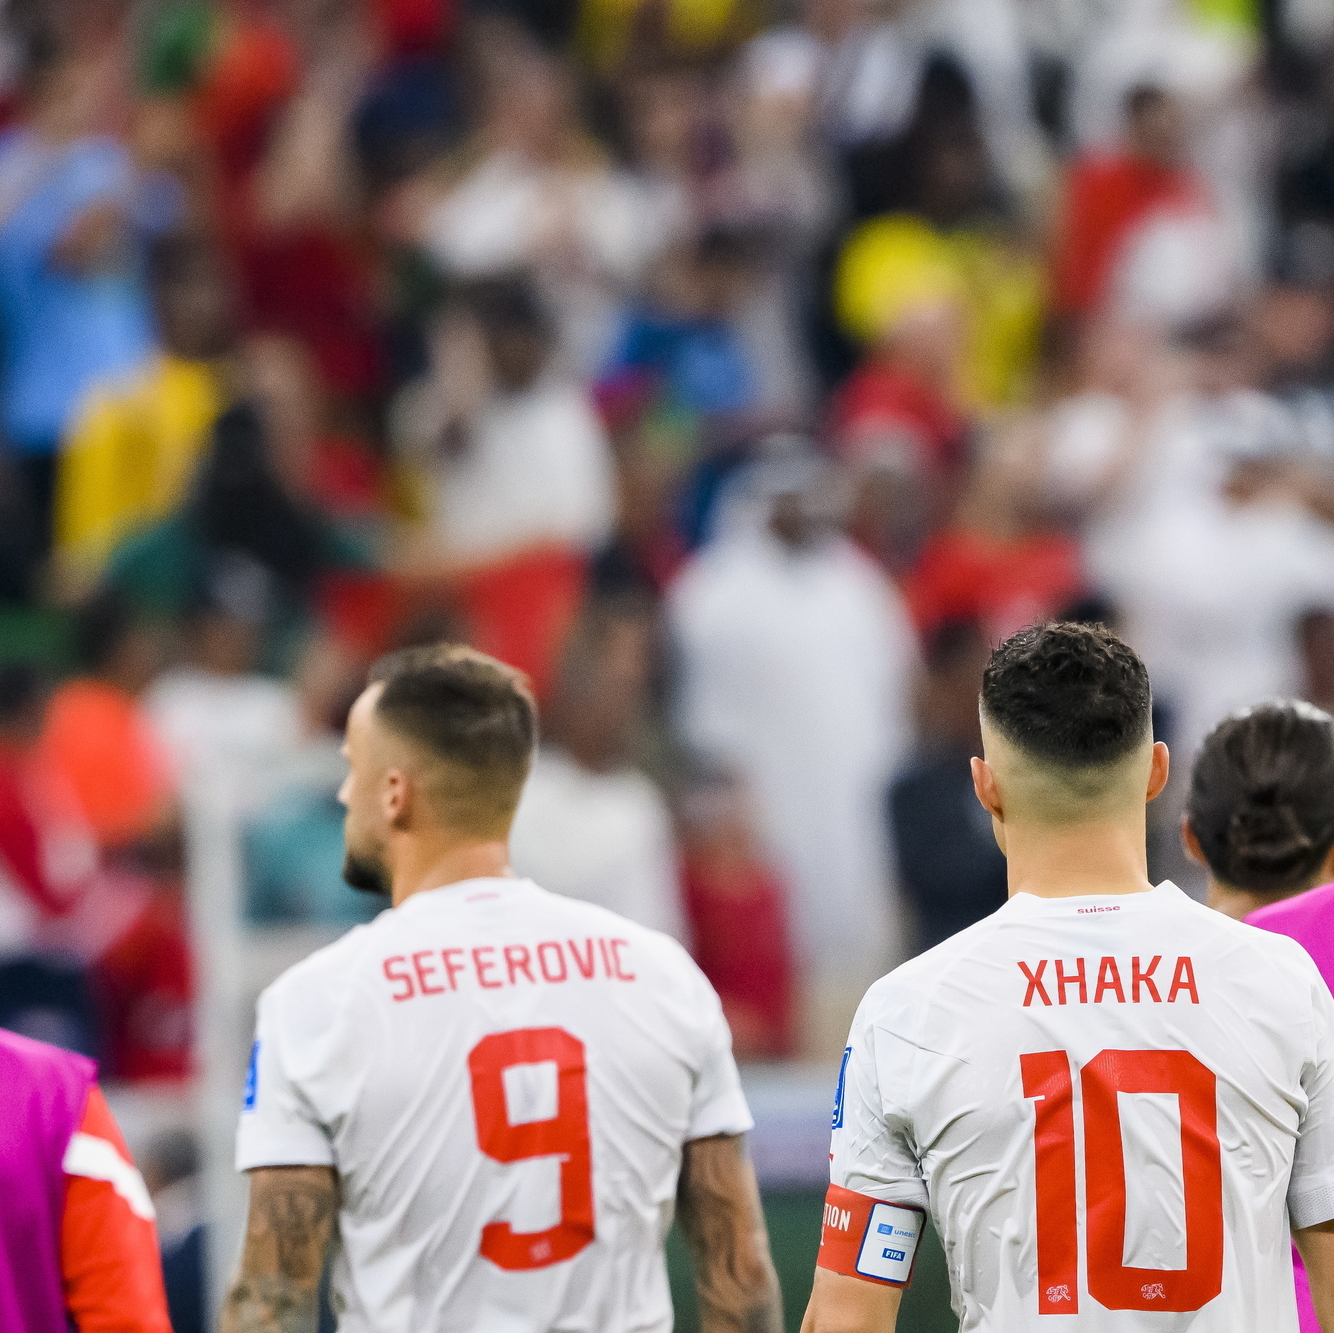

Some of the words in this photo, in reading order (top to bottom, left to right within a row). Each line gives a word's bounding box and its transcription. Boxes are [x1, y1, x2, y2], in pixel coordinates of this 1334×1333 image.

[1077, 904, 1121, 914] suisse
[382, 937, 637, 1003] SEFEROVIC
[1017, 955, 1200, 1007] XHAKA
[465, 1025, 597, 1273] 9
[1018, 1048, 1223, 1316] 10
[823, 1203, 851, 1232] TION
[885, 1250, 902, 1260] FIFA
